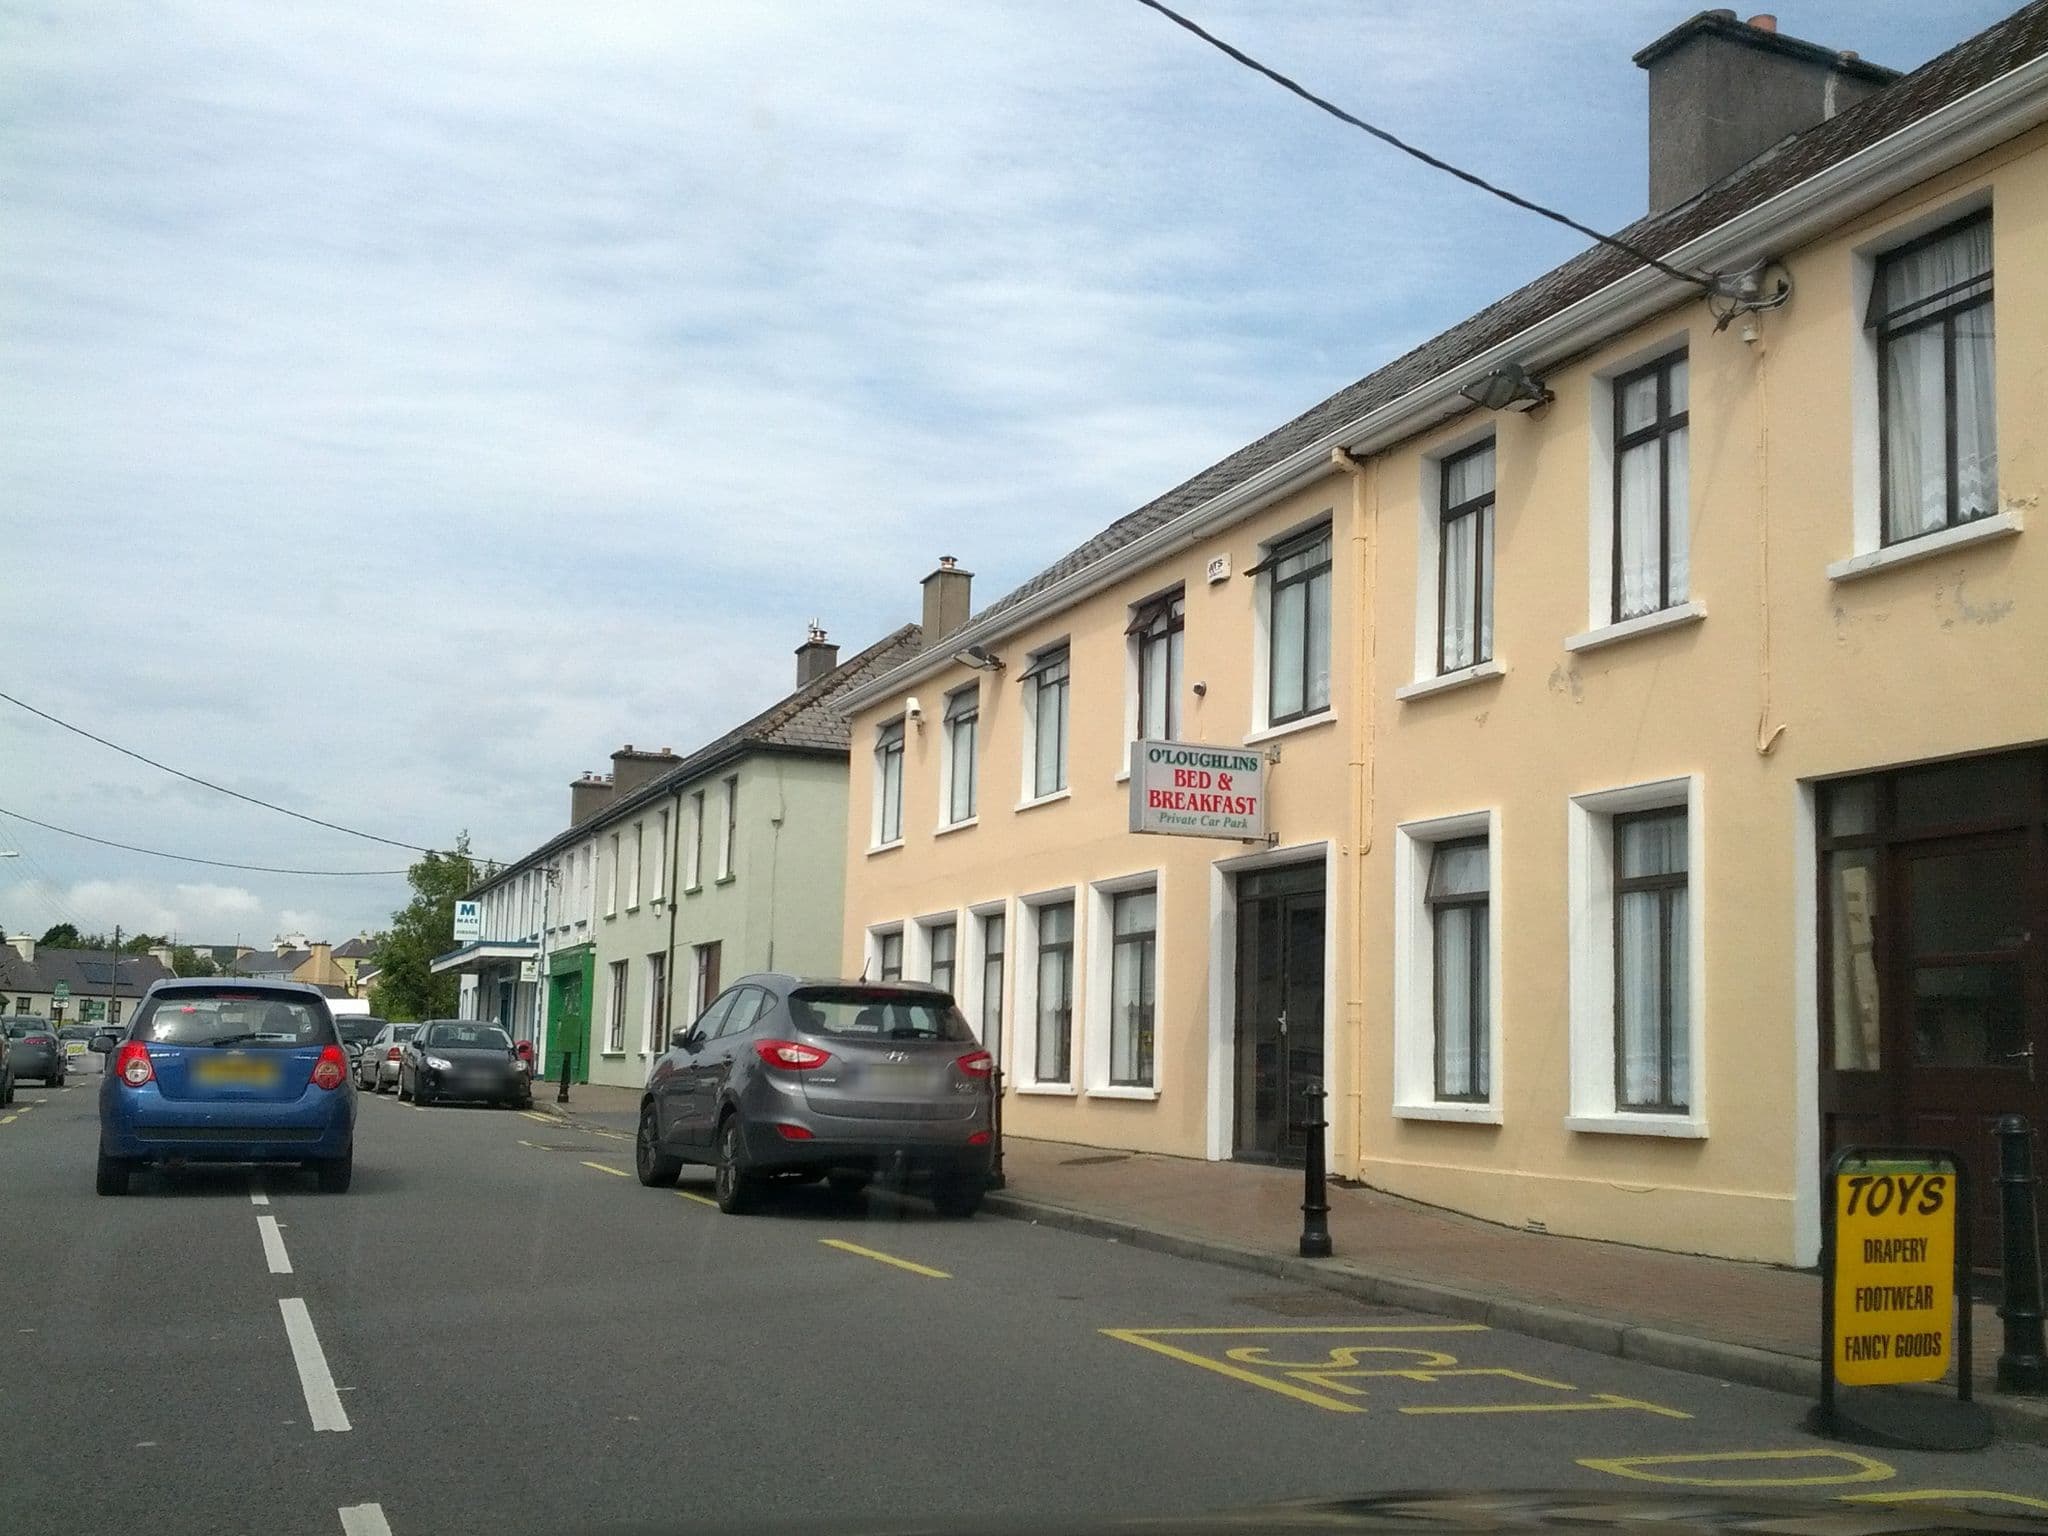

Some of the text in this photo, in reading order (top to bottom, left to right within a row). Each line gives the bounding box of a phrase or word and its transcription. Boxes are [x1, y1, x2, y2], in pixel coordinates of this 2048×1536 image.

[1148, 748, 1258, 772] O'LOUGHLINS
[1174, 768, 1233, 791] BED &
[1148, 789, 1257, 815] BREAKFAST
[1158, 811, 1249, 829] Private Car Park
[460, 904, 475, 915] M
[1847, 1175, 1946, 1217] TOYS
[1863, 1237, 1928, 1264] DRAPERY
[1855, 1284, 1934, 1312] FOOTWEAR
[1844, 1331, 1942, 1361] FANCY GOODS
